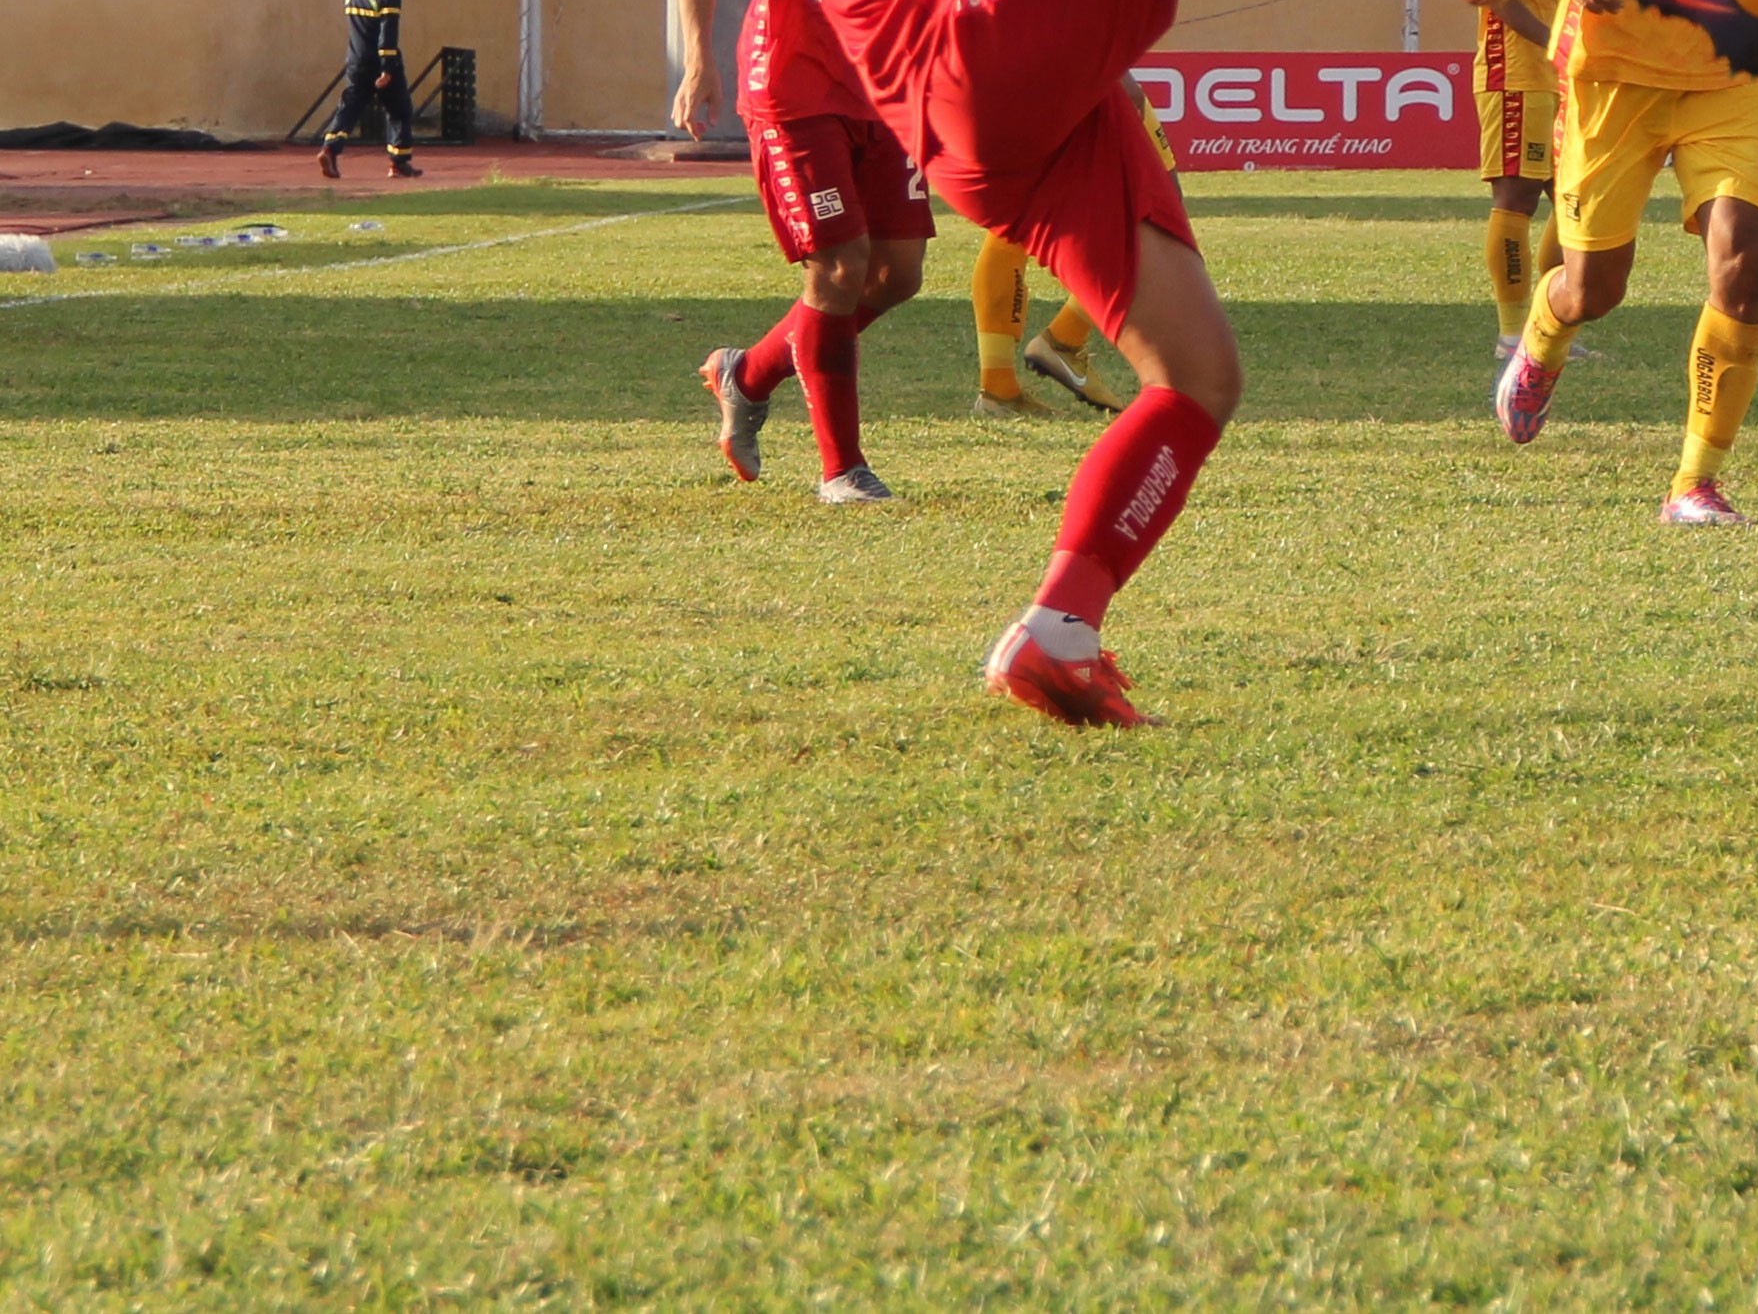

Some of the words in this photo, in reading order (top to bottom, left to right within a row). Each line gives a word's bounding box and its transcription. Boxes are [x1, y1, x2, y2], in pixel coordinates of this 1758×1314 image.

[1128, 67, 1454, 123] DELTA
[1188, 134, 1231, 155] THỜI
[1236, 137, 1300, 155] TRANG
[1342, 138, 1393, 155] THAO
[1696, 346, 1716, 416] JOGARBOLA
[1113, 444, 1180, 542] JOGARBOLA
